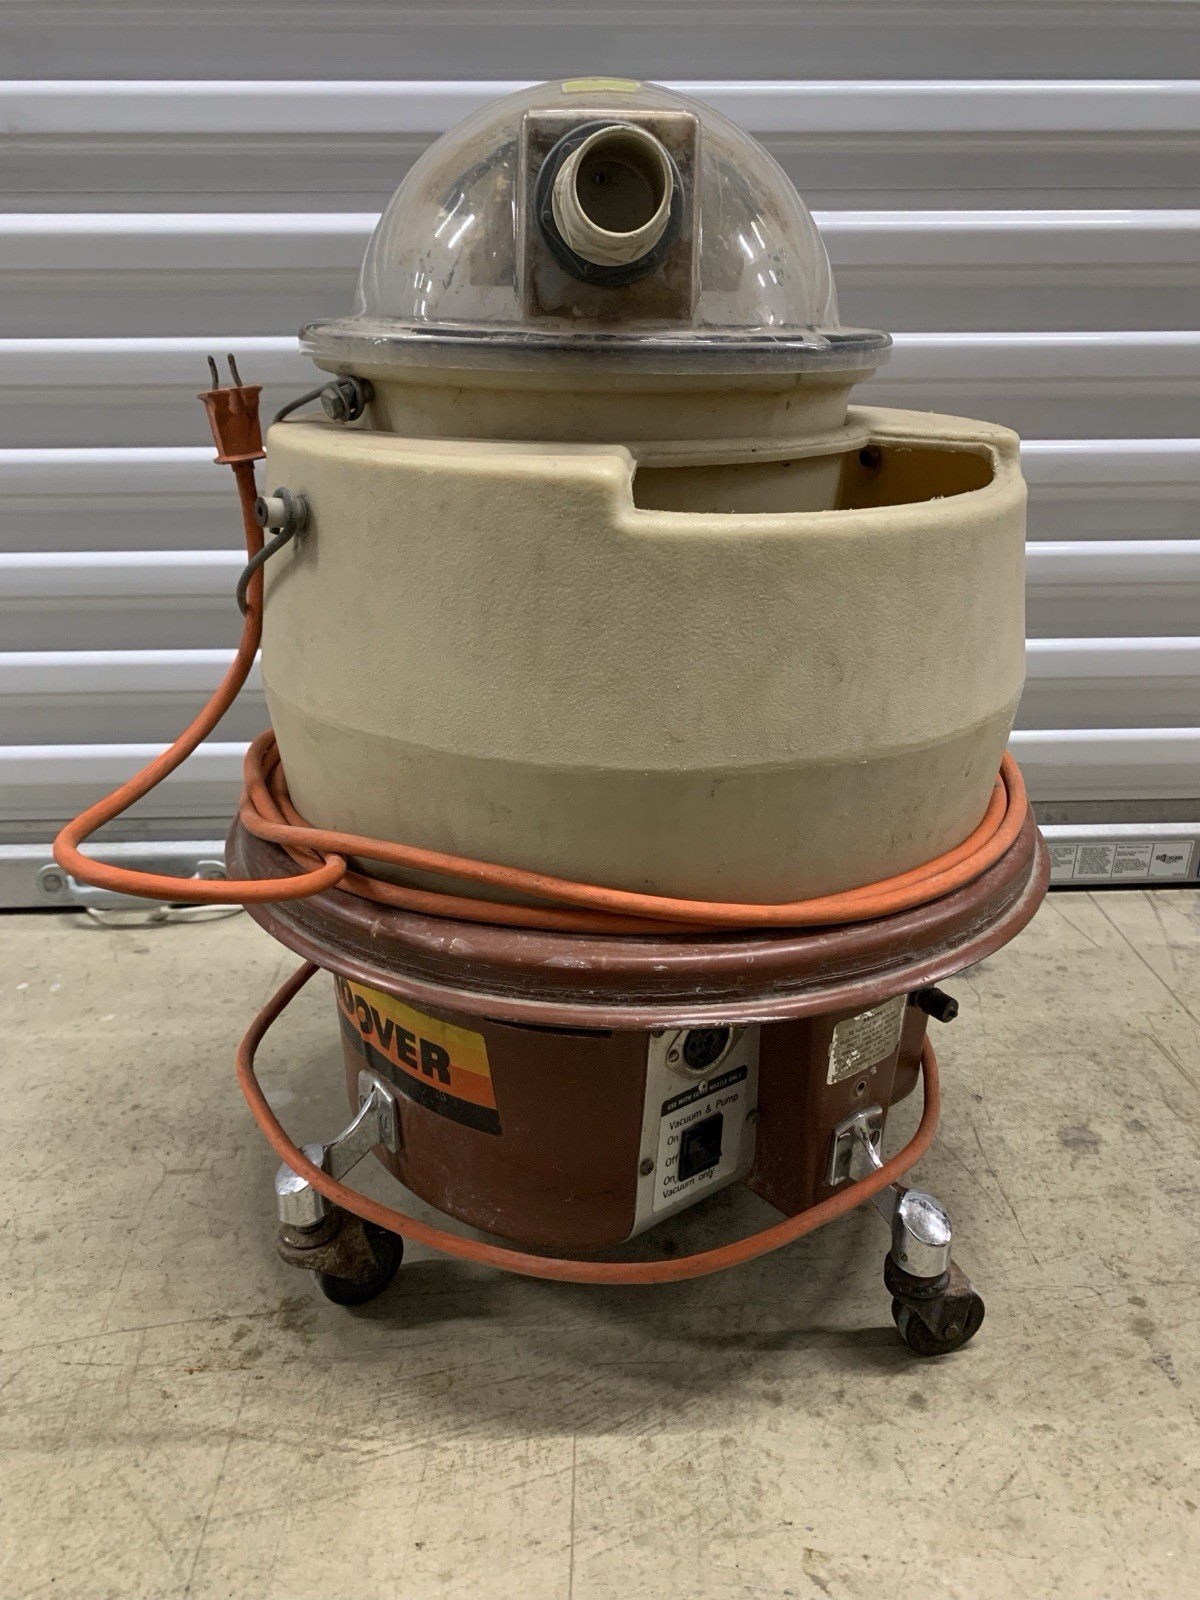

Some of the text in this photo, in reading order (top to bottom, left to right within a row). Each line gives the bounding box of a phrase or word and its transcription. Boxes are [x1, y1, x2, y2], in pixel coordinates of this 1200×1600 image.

[669, 1093, 739, 1130] Vacuum & Pump
[667, 1135, 679, 1146] On
[665, 1153, 680, 1167] Off
[662, 1168, 715, 1198] Vacuum only
[663, 1174, 675, 1186] On
